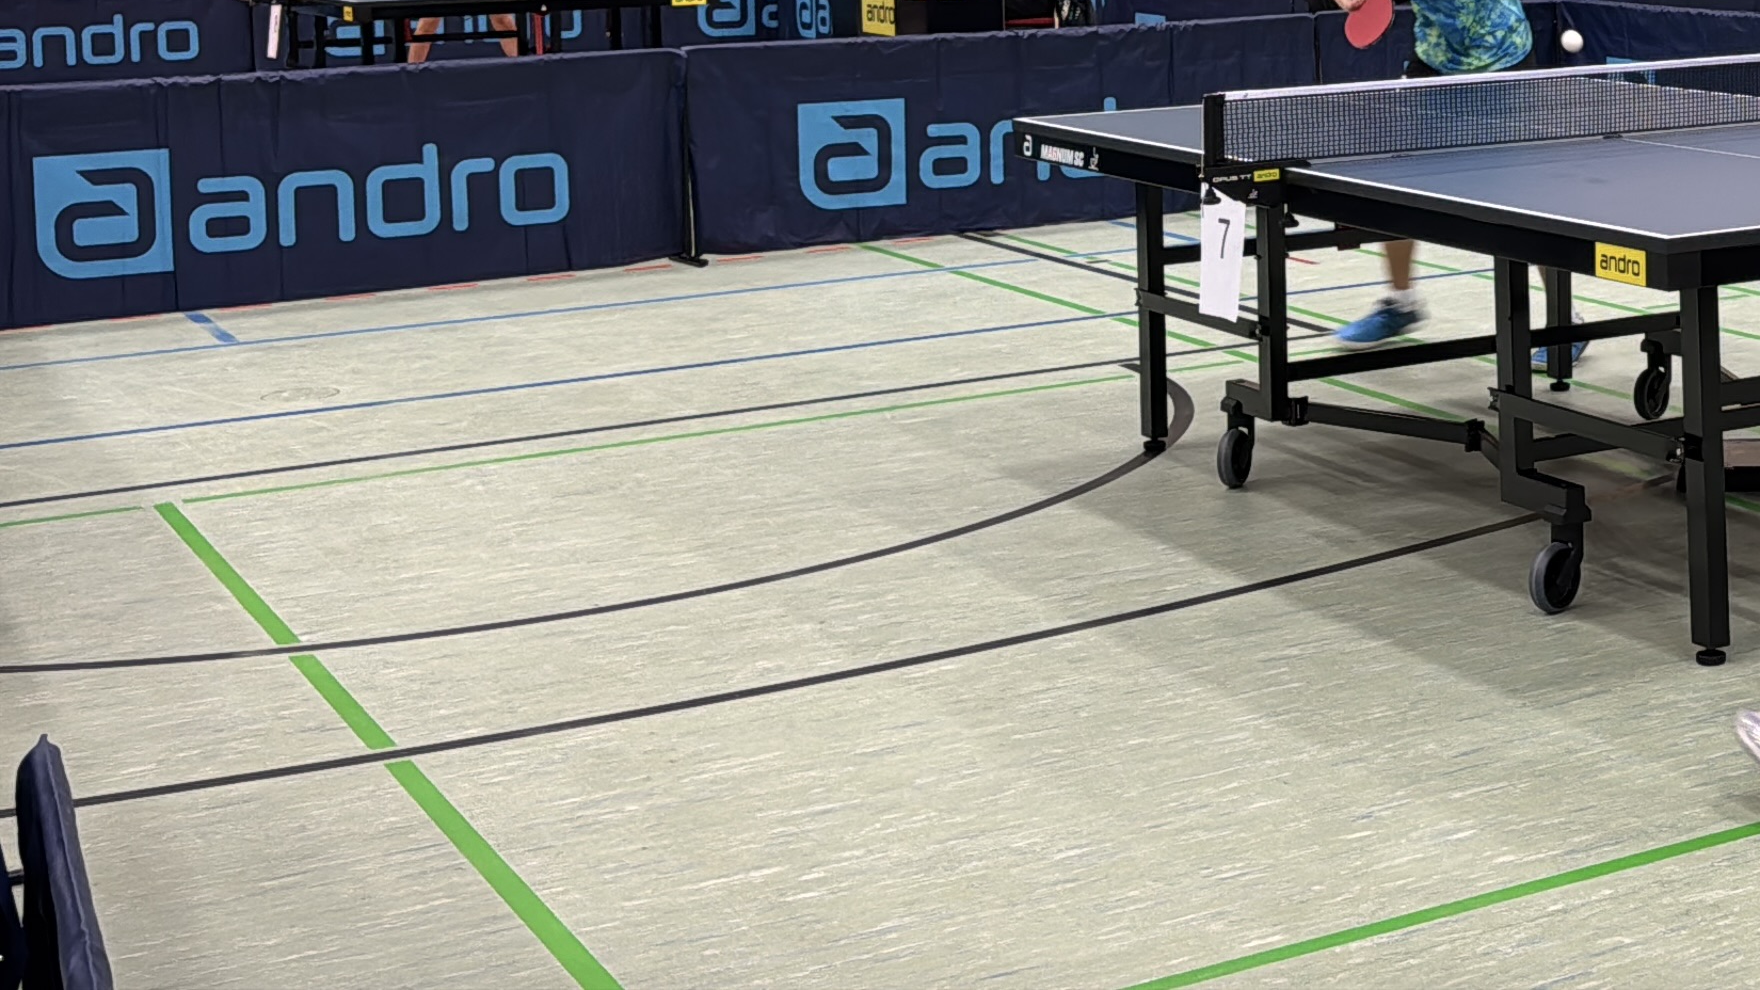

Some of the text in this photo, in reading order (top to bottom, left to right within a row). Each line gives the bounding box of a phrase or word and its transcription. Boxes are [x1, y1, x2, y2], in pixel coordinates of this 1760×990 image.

[866, 0, 895, 25] andro
[0, 13, 200, 70] andro
[1040, 143, 1085, 168] MAGNUM SC
[1212, 170, 1278, 183] OPUS TT andro
[188, 142, 570, 254] andro
[1218, 218, 1231, 259] 7
[1600, 253, 1640, 277] andro
